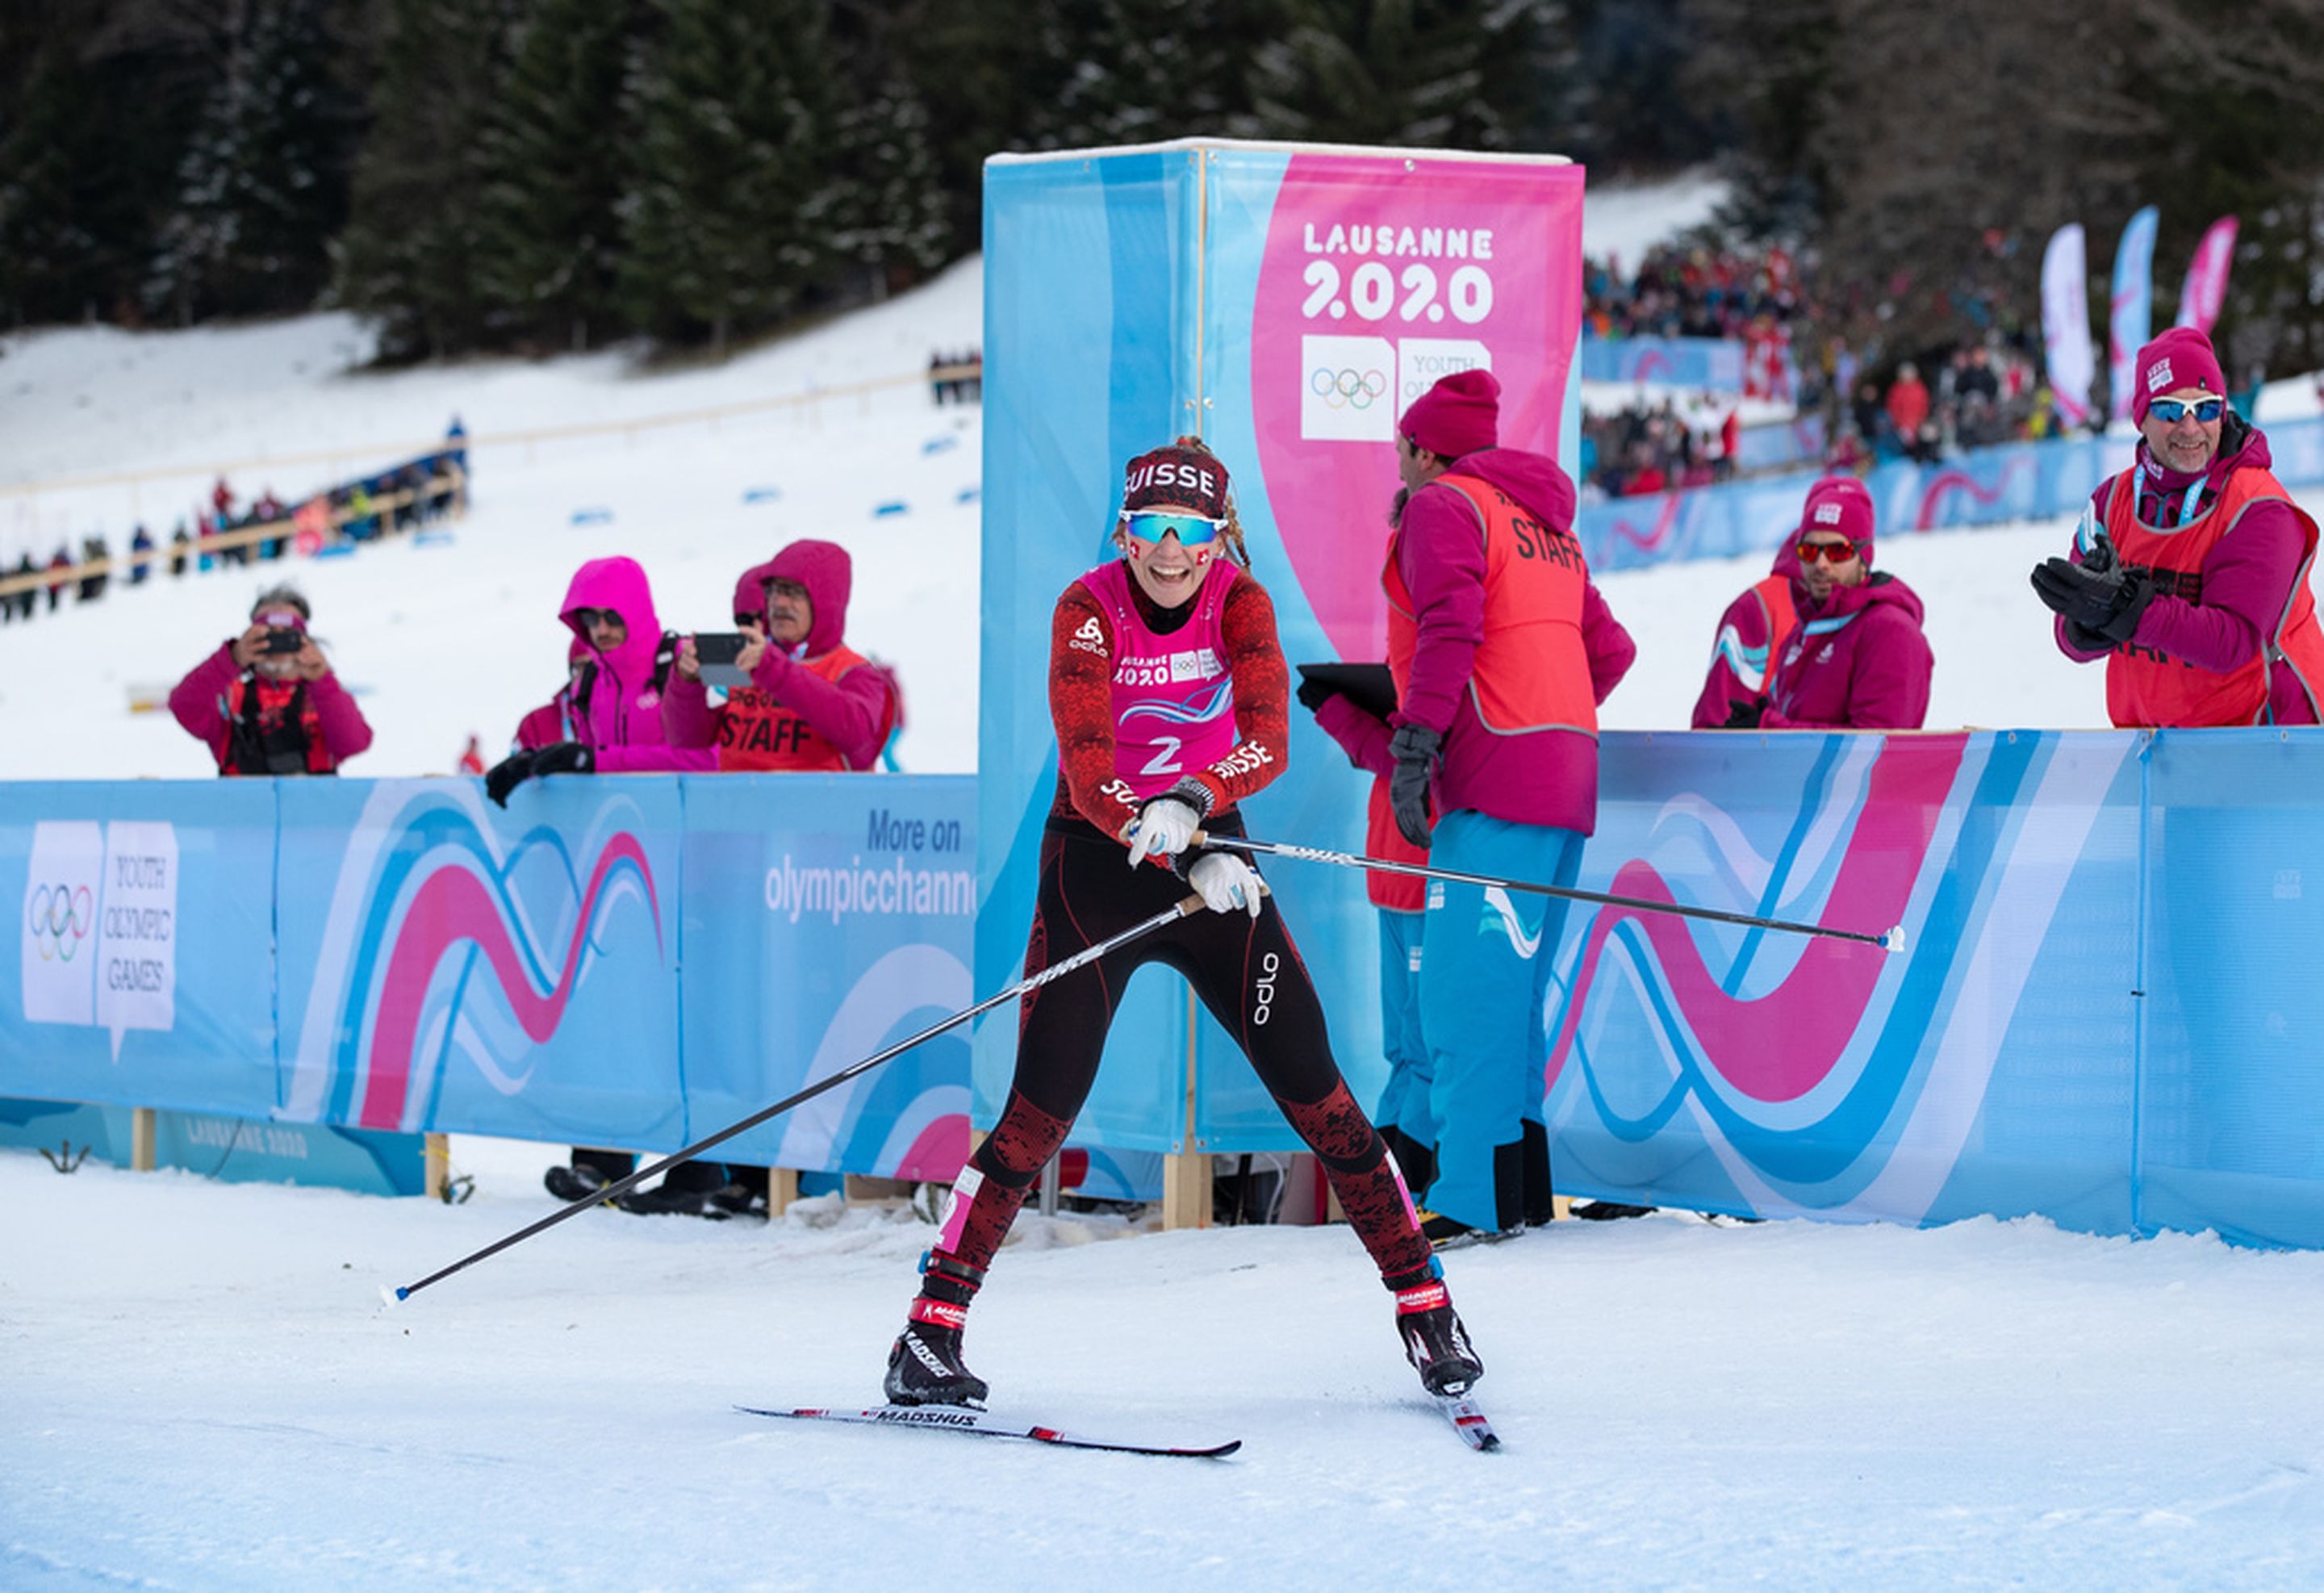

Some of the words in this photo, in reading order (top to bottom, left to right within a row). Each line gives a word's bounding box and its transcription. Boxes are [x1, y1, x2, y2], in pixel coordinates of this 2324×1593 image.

[1303, 223, 1494, 260] LAUSANNE
[1413, 355, 1475, 374] YOUTH
[1511, 516, 1582, 575] STAFF
[1069, 639, 1108, 659] odlo
[721, 712, 811, 755] STAFF
[1139, 736, 1183, 775] 2
[867, 809, 925, 851] More
[931, 819, 960, 852] on
[115, 855, 166, 889] YOUTH
[104, 906, 171, 942] OLYMPIC
[107, 958, 165, 992] GAMES
[1253, 952, 1280, 1026] odlo
[877, 1411, 977, 1427] MADSHUS
